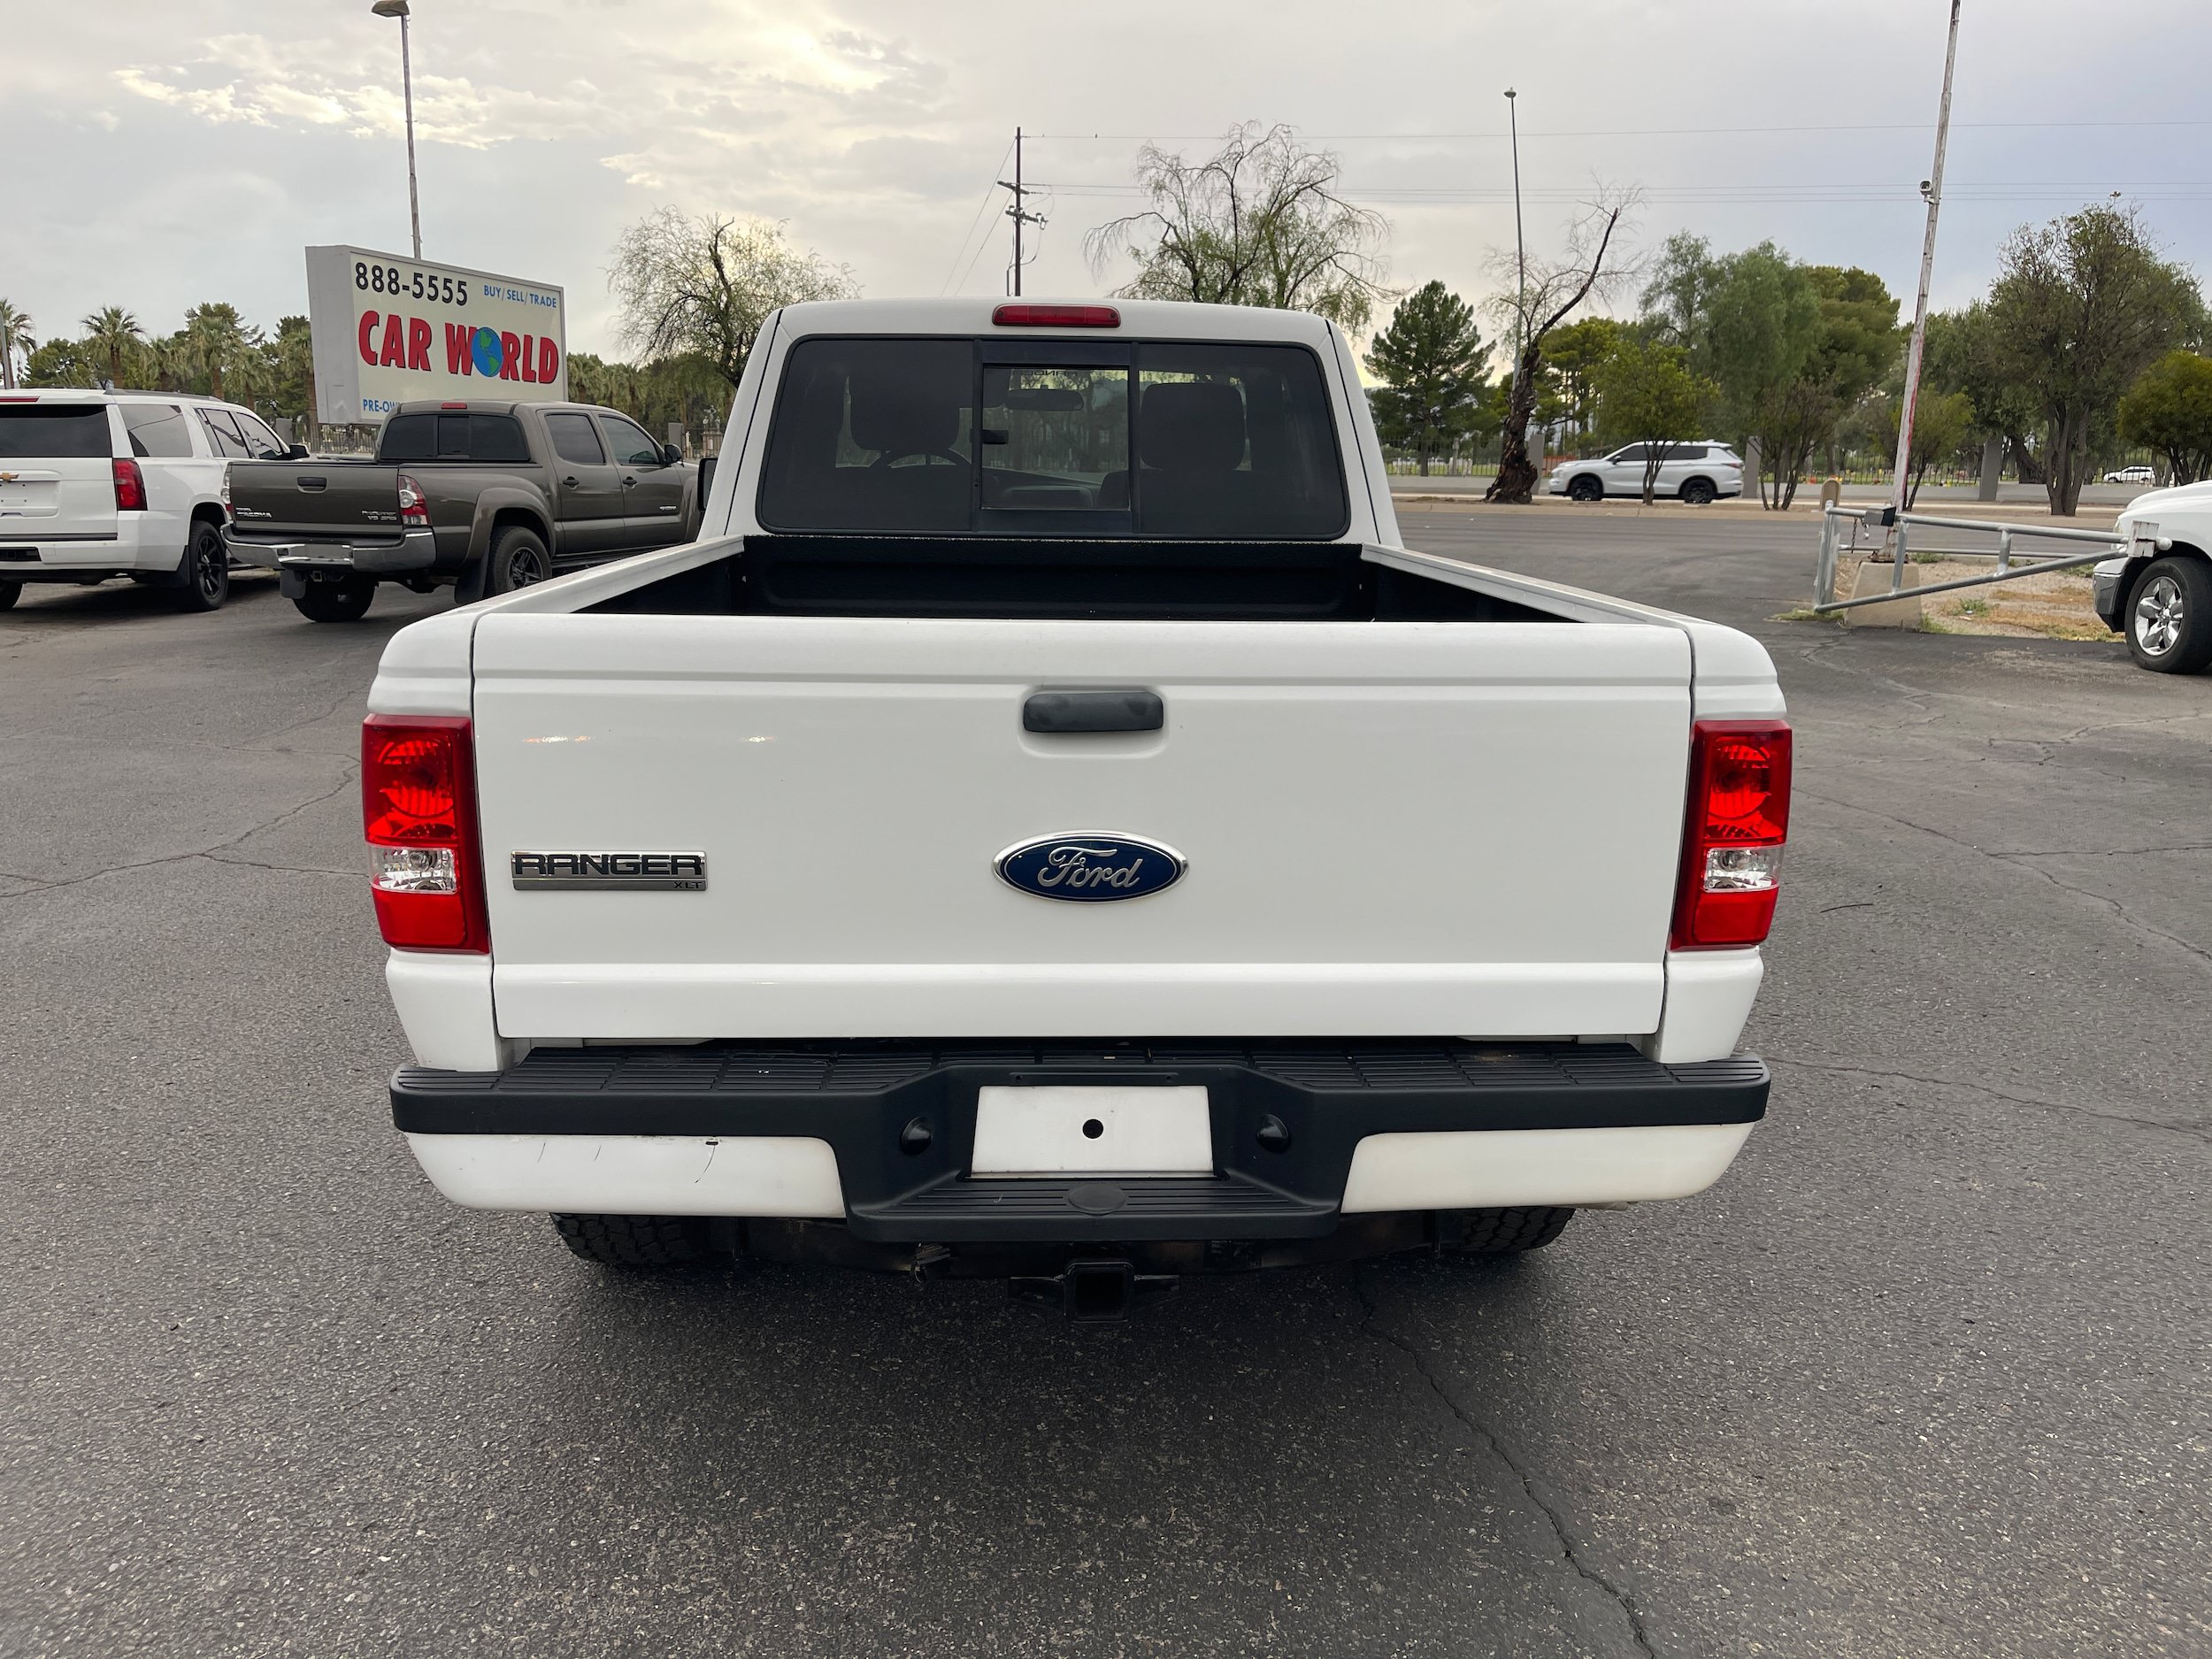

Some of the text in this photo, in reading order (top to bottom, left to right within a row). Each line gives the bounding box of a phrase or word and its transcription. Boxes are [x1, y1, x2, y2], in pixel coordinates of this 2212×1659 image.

[356, 262, 467, 306] 888-5555
[358, 311, 432, 371] CAR
[514, 853, 702, 876] RANGER
[1037, 846, 1143, 888] Ford
